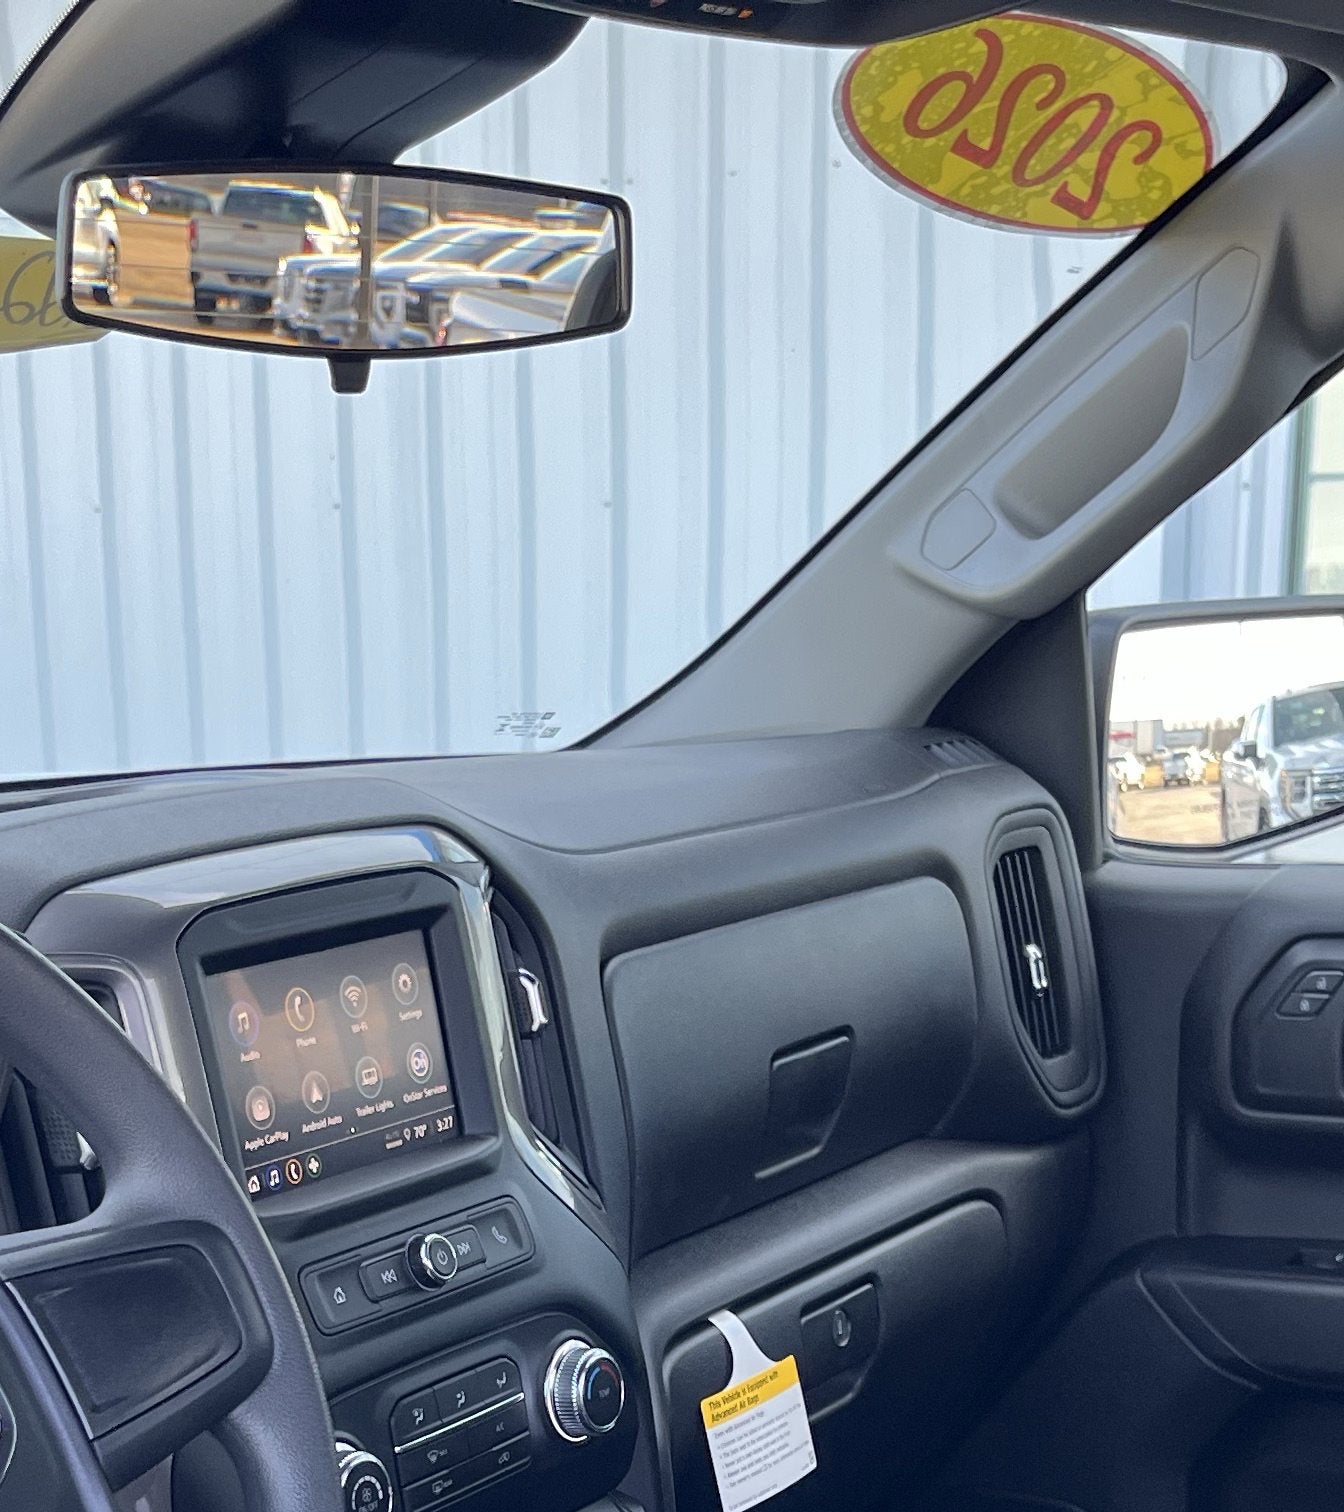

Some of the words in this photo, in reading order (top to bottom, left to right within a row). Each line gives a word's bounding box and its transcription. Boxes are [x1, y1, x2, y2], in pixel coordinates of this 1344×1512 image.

[302, 1117, 327, 1134] Android
[327, 1114, 344, 1127] Auto
[436, 1115, 454, 1133] 3:27
[244, 1137, 265, 1152] Apple
[264, 1130, 290, 1147] CarPlay
